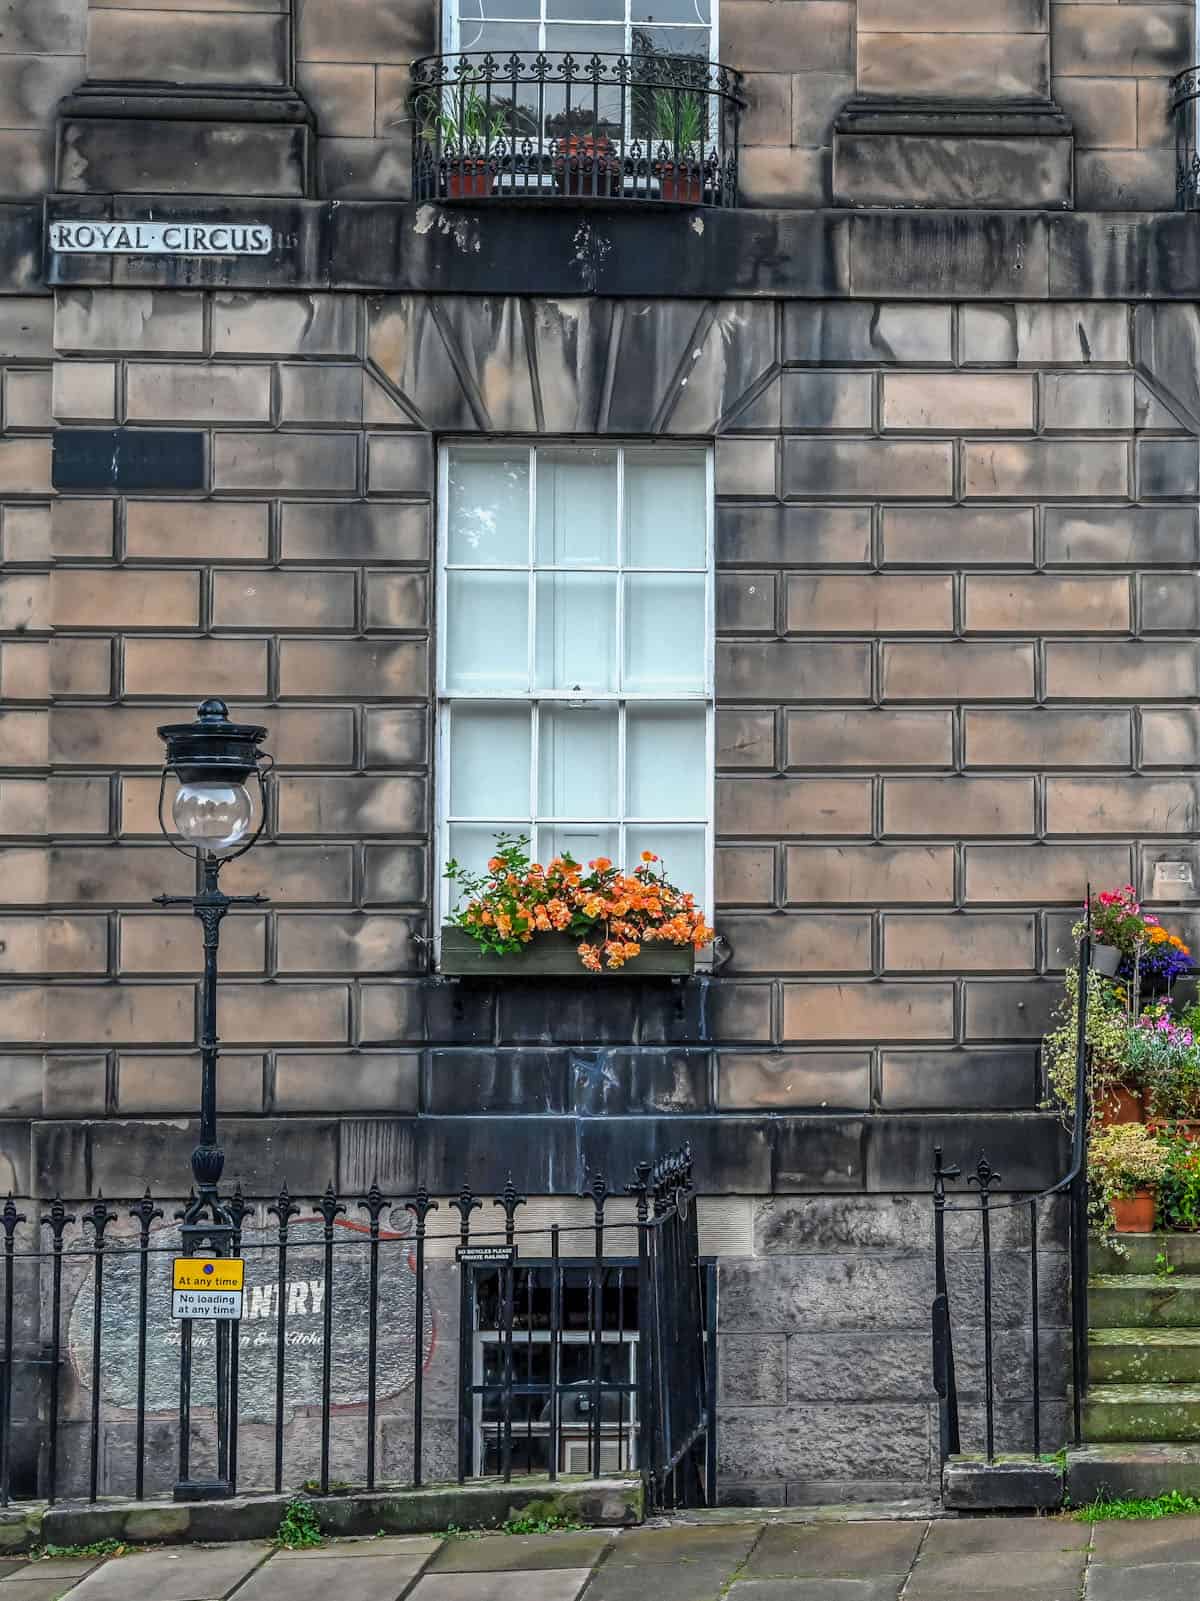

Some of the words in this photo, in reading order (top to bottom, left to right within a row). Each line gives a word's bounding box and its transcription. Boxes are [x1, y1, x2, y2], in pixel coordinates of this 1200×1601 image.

[57, 225, 149, 249] ROYAL
[162, 227, 264, 251] CIRCUS
[178, 1276, 191, 1286] At
[193, 1278, 213, 1287] any
[215, 1276, 238, 1286] time
[179, 1294, 194, 1303] No
[197, 1295, 235, 1305] loading
[178, 1305, 189, 1314] at
[191, 1307, 211, 1315] any
[213, 1305, 235, 1314] time
